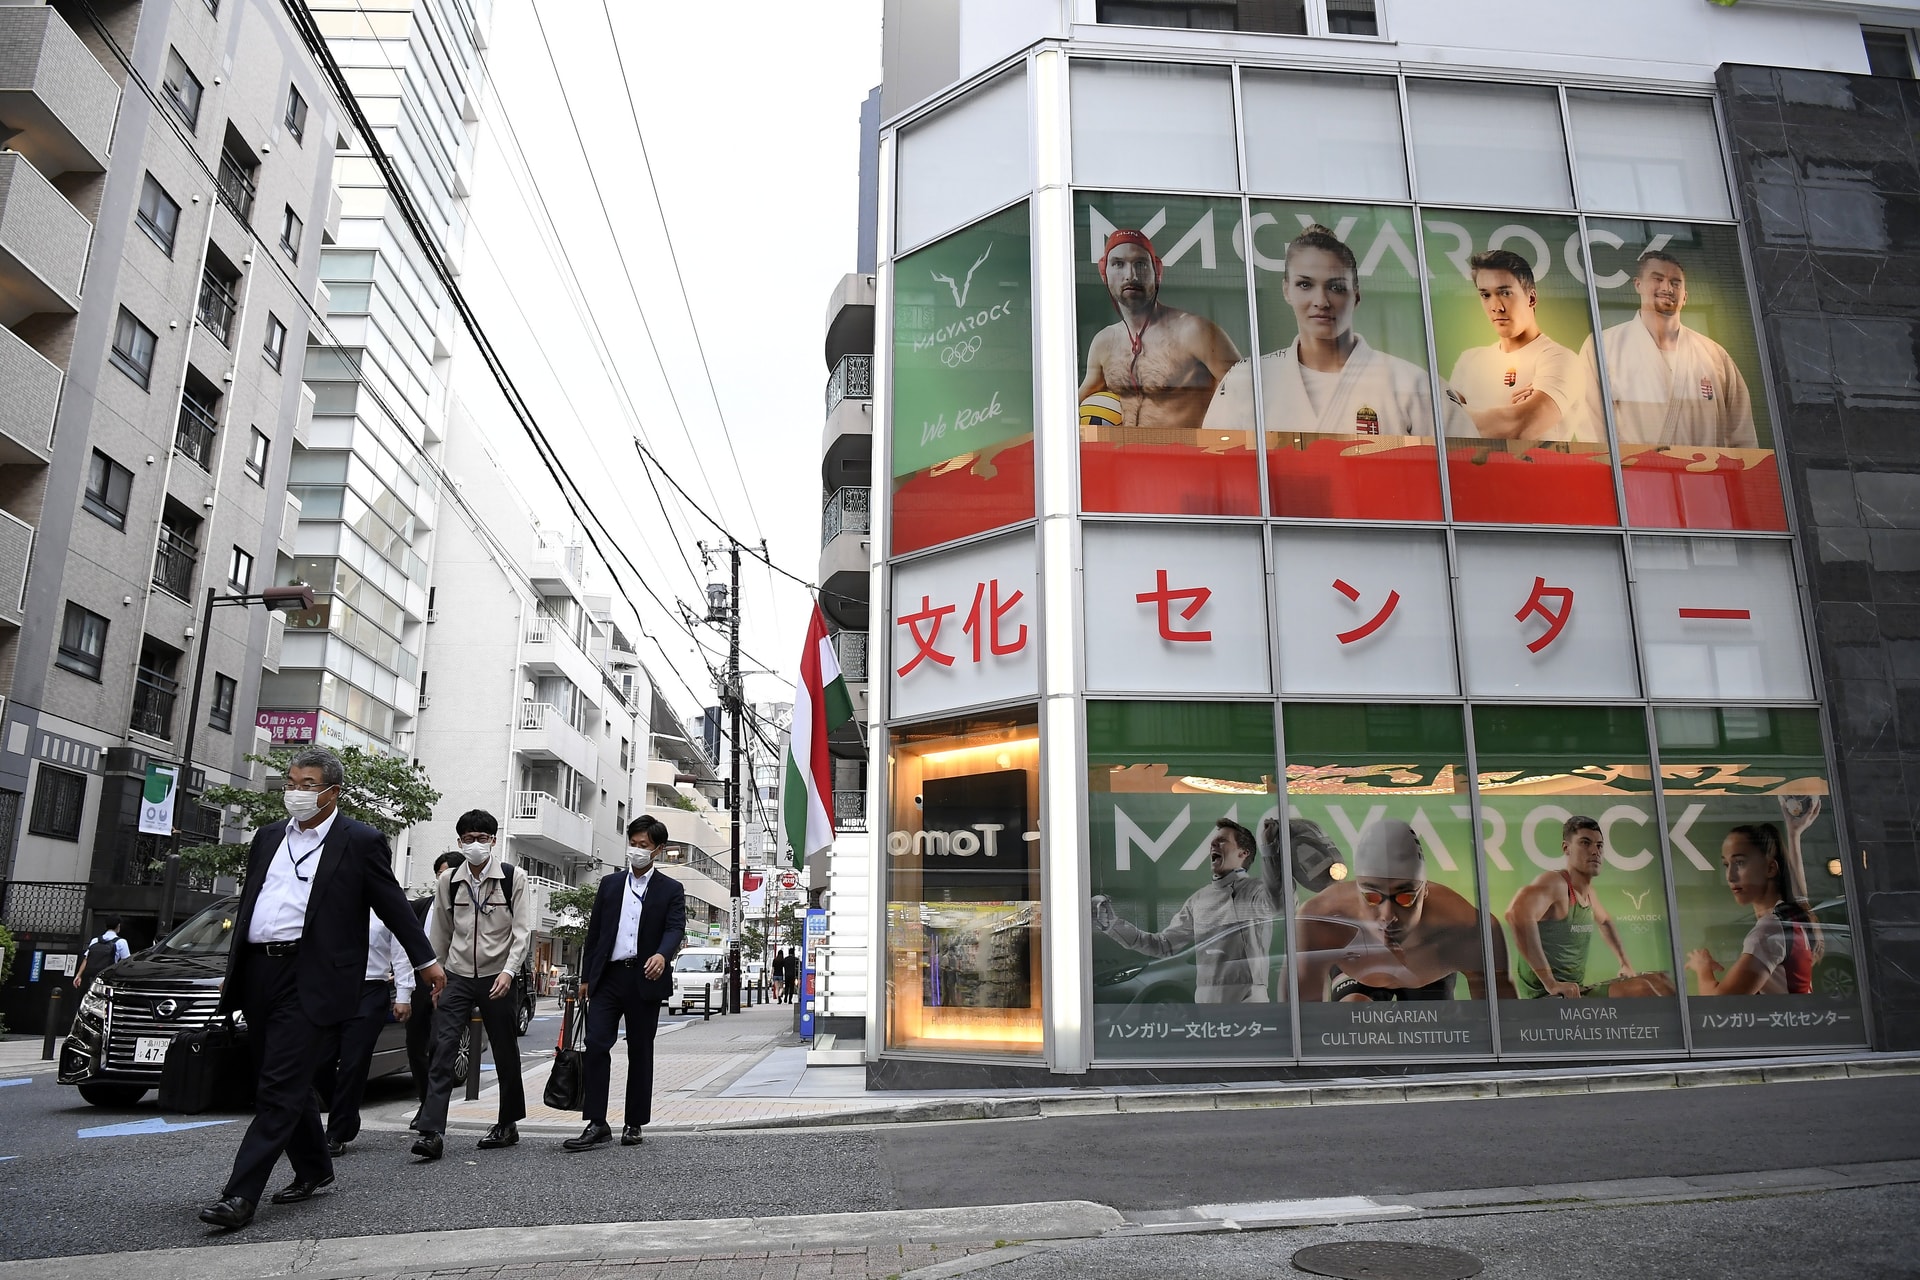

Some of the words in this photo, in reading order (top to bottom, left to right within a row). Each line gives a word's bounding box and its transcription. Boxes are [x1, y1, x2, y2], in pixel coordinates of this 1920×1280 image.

[914, 300, 1011, 352] MAGYAROCK
[920, 414, 947, 447] We
[954, 391, 1003, 431] Rock
[1114, 802, 1715, 871] MAYAROCK
[1351, 1010, 1438, 1024] HUNGARIAN
[1560, 1007, 1618, 1020] MAGYAR
[1702, 1010, 1851, 1028] ハンガリー文化センター
[1108, 1021, 1277, 1039] ハンガリー文化センター
[1321, 1032, 1395, 1046] CULTURAL
[1398, 1031, 1470, 1044] INSTITUTE
[1520, 1024, 1603, 1041] KULTURÁLIS
[1605, 1024, 1660, 1040] INTÉZET
